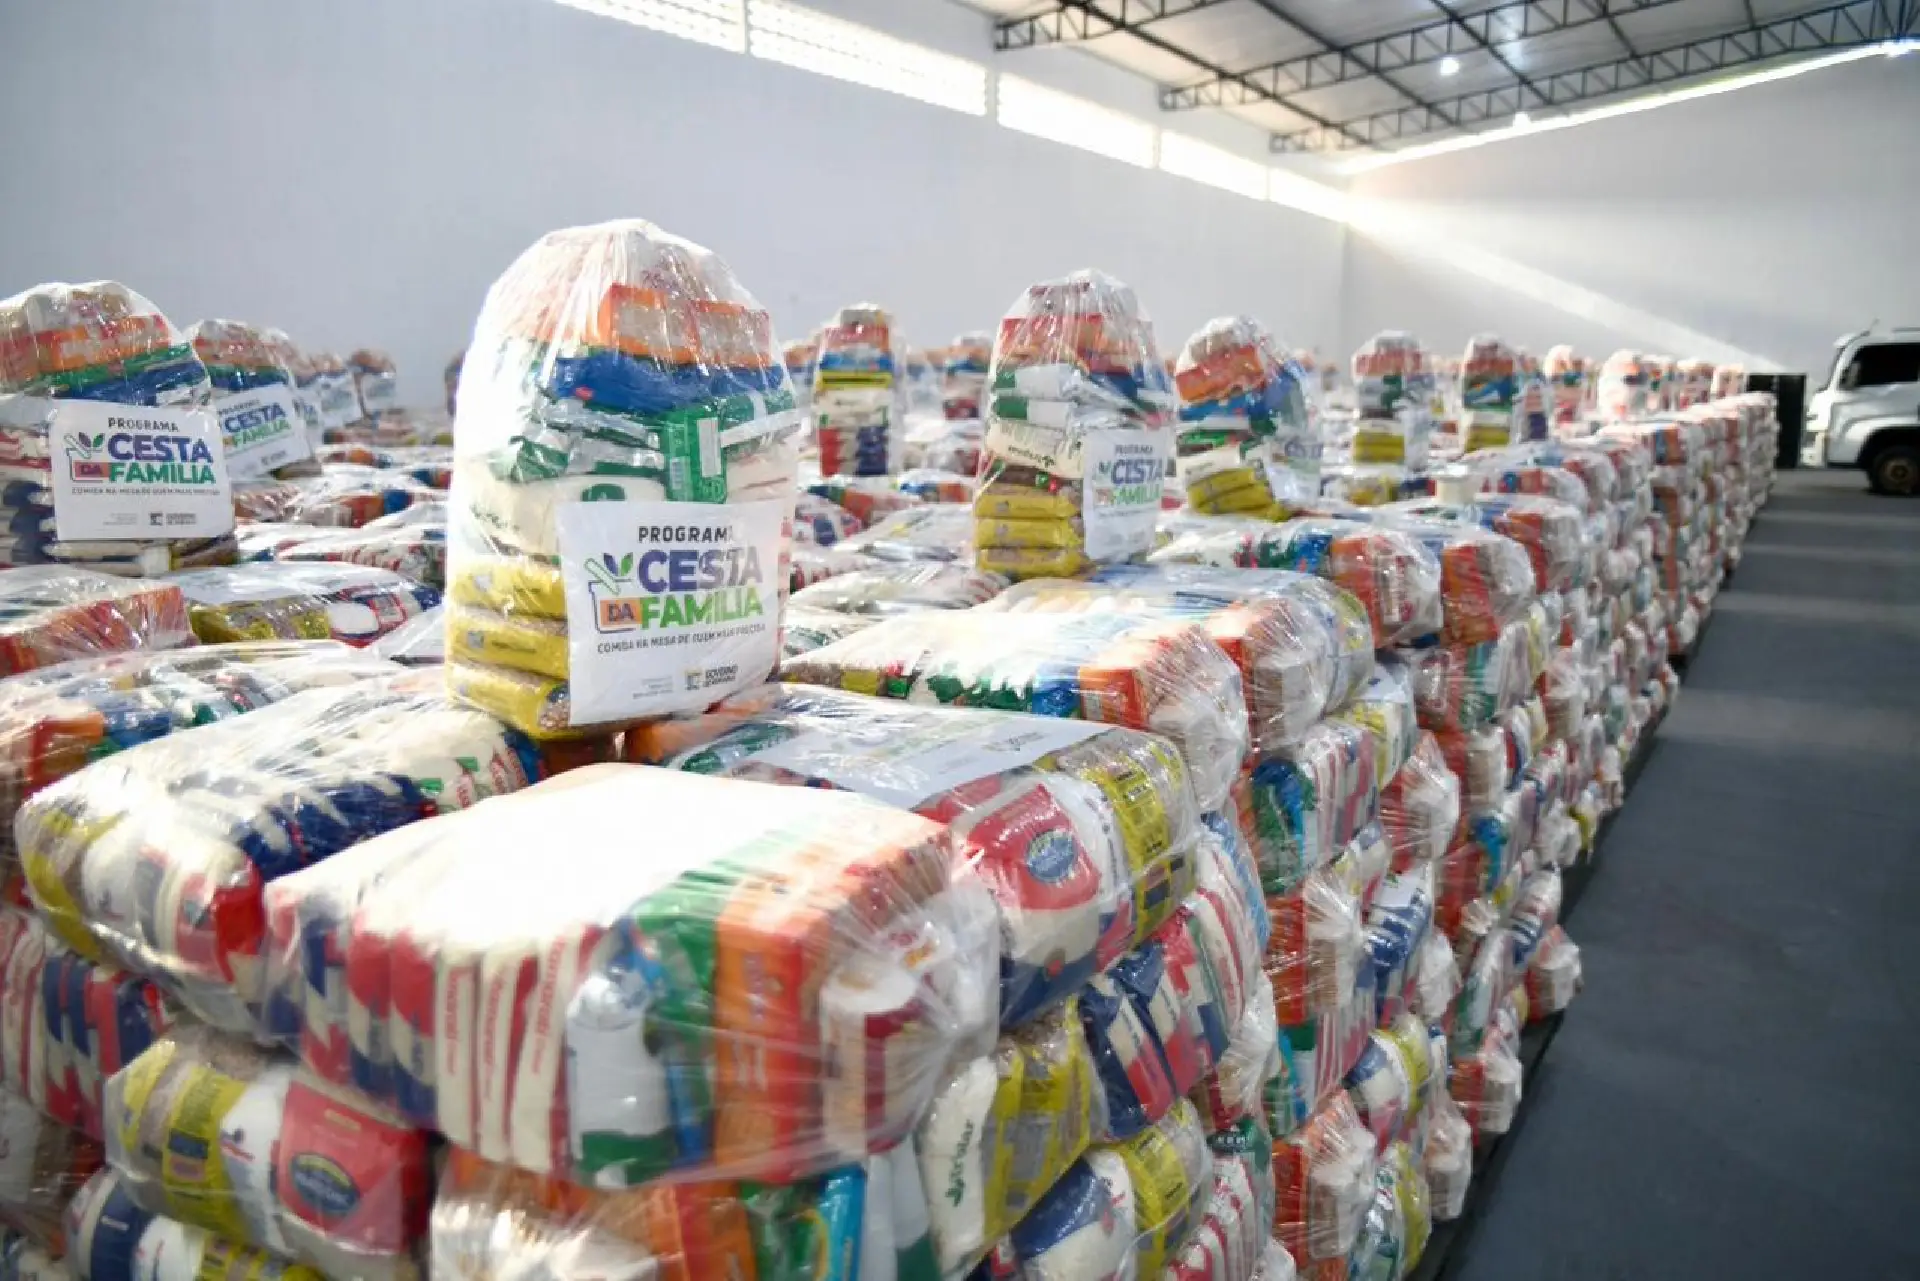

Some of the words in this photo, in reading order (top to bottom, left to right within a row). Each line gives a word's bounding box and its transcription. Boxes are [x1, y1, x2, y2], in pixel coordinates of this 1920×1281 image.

[108, 417, 179, 432] PROGRAMA
[225, 403, 286, 432] CESTA
[107, 433, 214, 463] CESTA
[1111, 459, 1162, 484] CESTA
[638, 546, 763, 593] CESTA
[607, 601, 635, 622] DA
[597, 640, 633, 654] COMIDA
